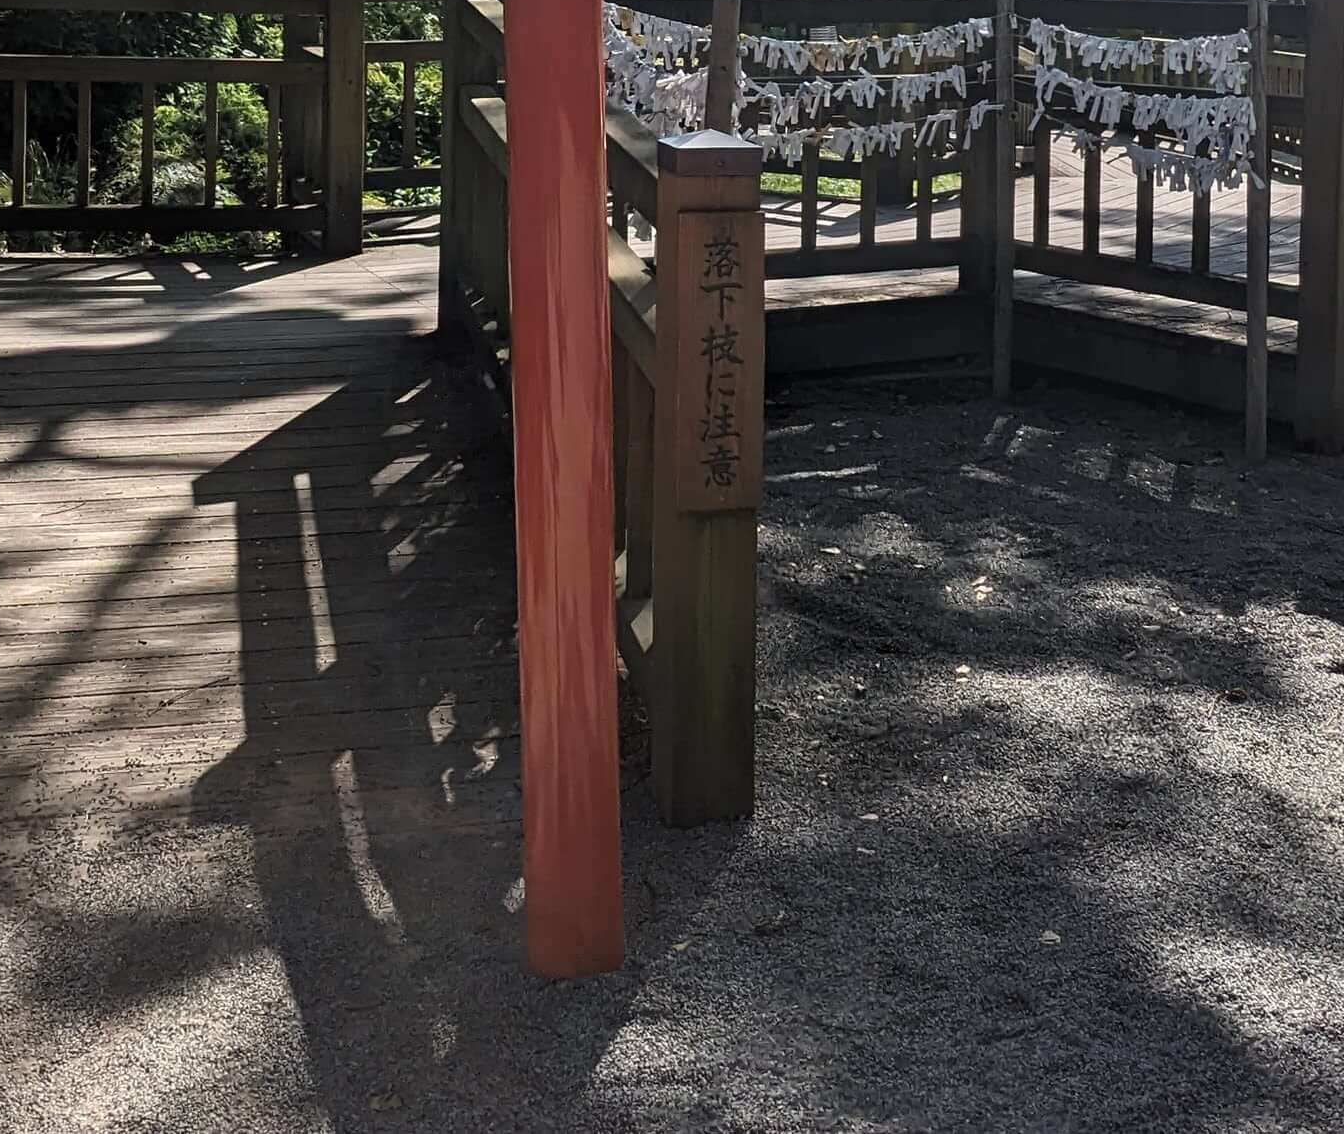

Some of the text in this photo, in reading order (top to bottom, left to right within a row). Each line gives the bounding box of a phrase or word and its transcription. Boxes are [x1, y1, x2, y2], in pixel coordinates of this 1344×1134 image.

[700, 238, 744, 489] 落下枝に注意
